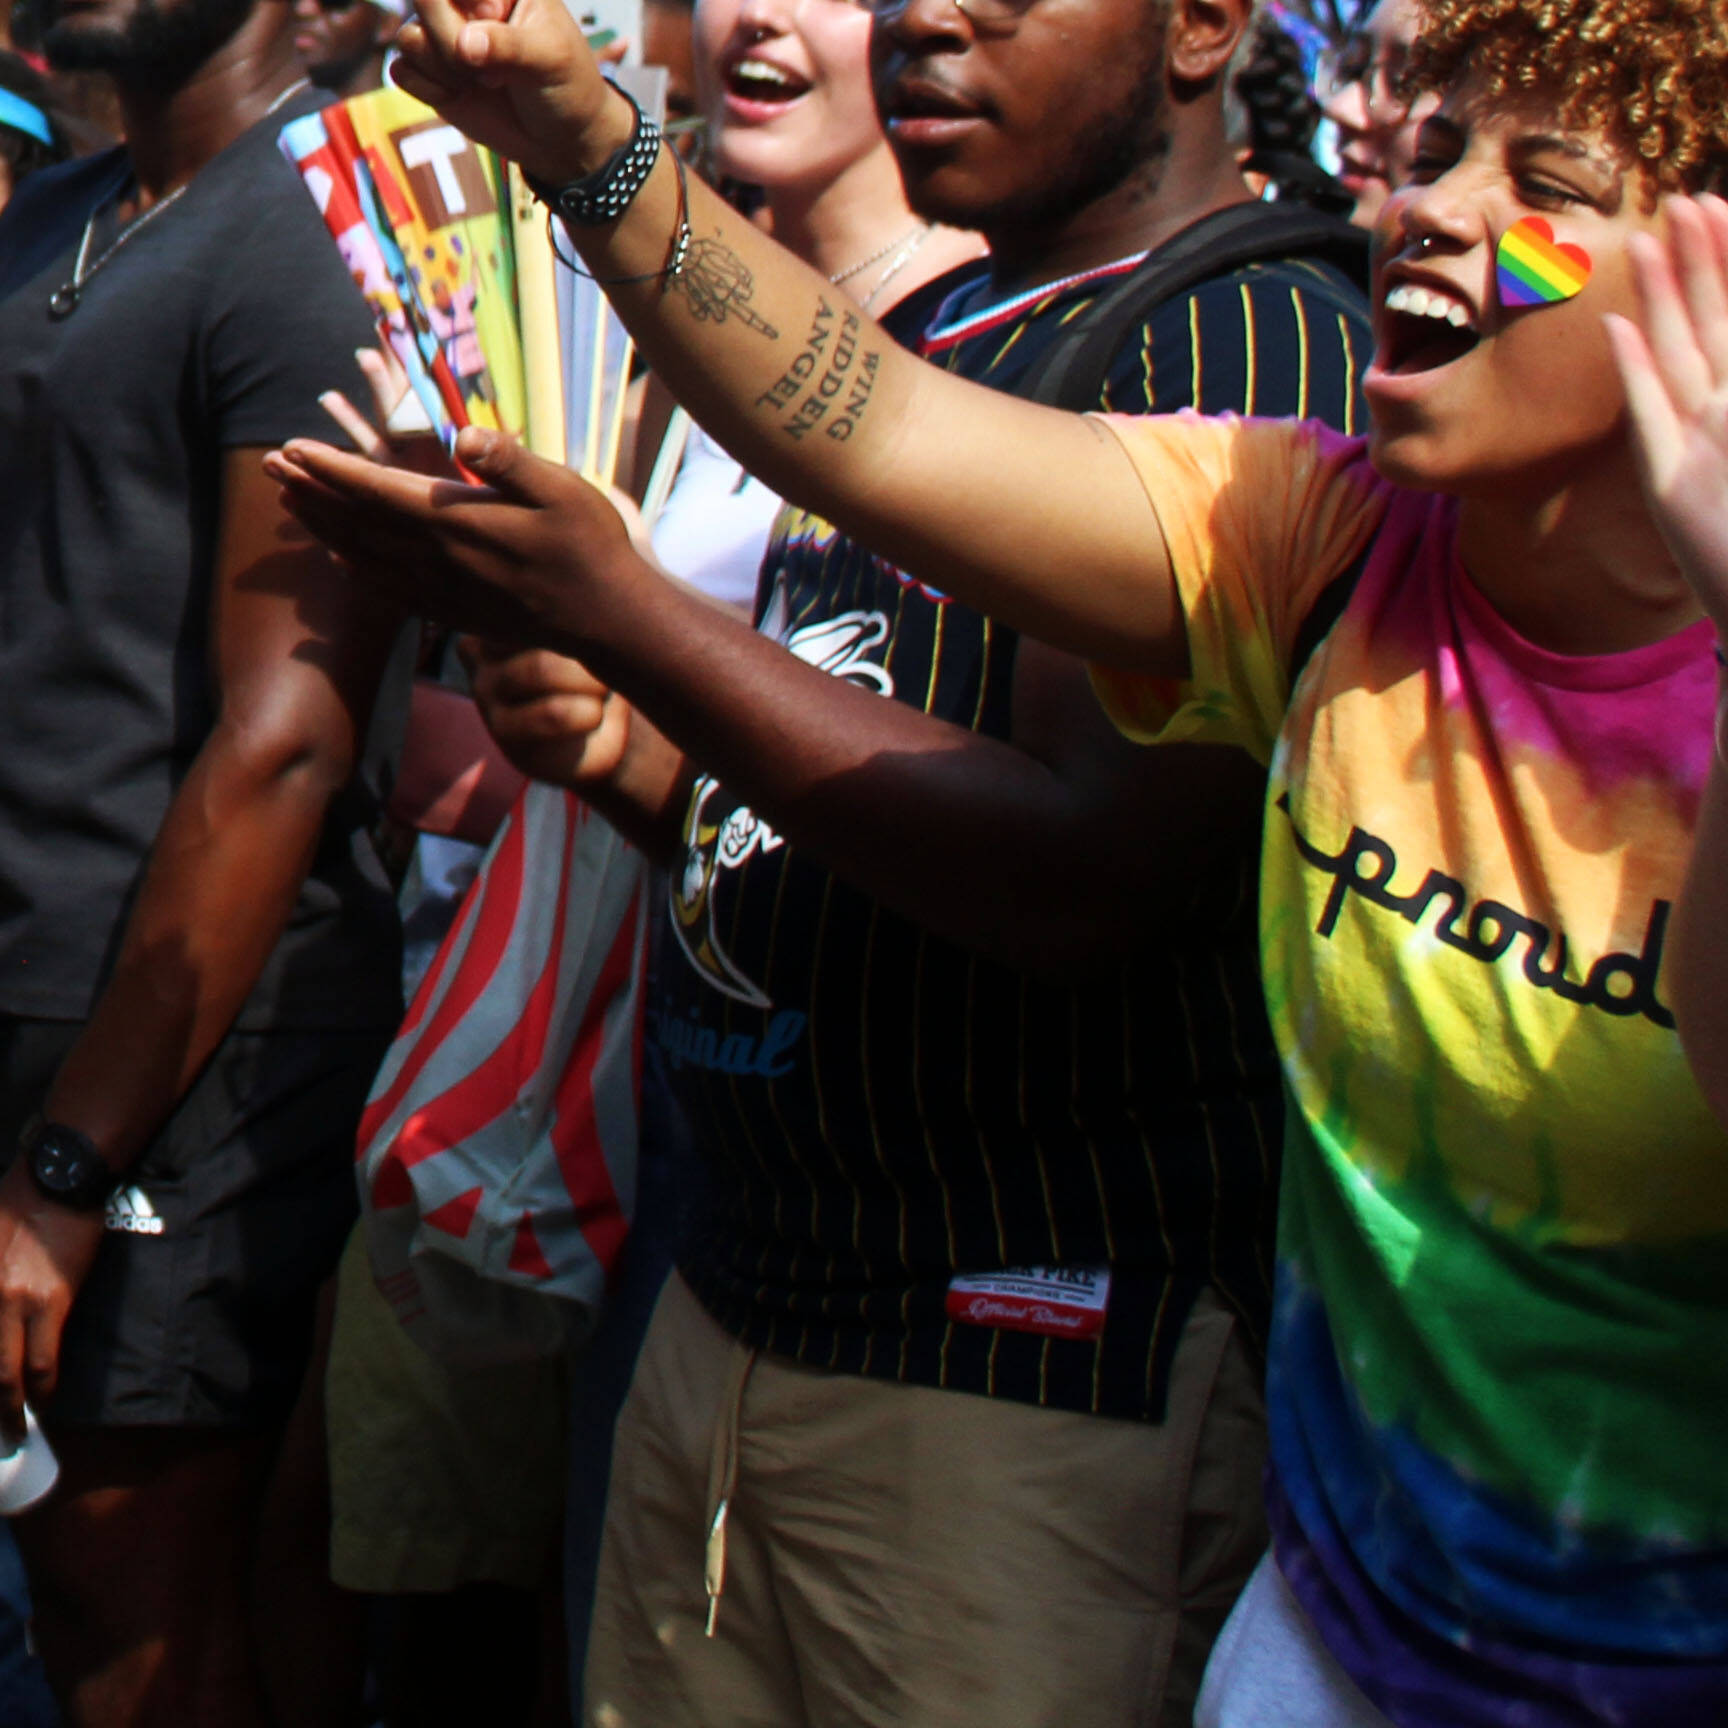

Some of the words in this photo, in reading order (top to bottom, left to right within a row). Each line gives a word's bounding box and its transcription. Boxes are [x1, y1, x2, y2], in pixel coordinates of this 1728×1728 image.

[755, 295, 833, 410] ANGEL
[783, 310, 860, 441] RIDDEN
[826, 350, 879, 441] WING
[1275, 792, 1677, 1029] proud
[652, 996, 807, 1078] iginal
